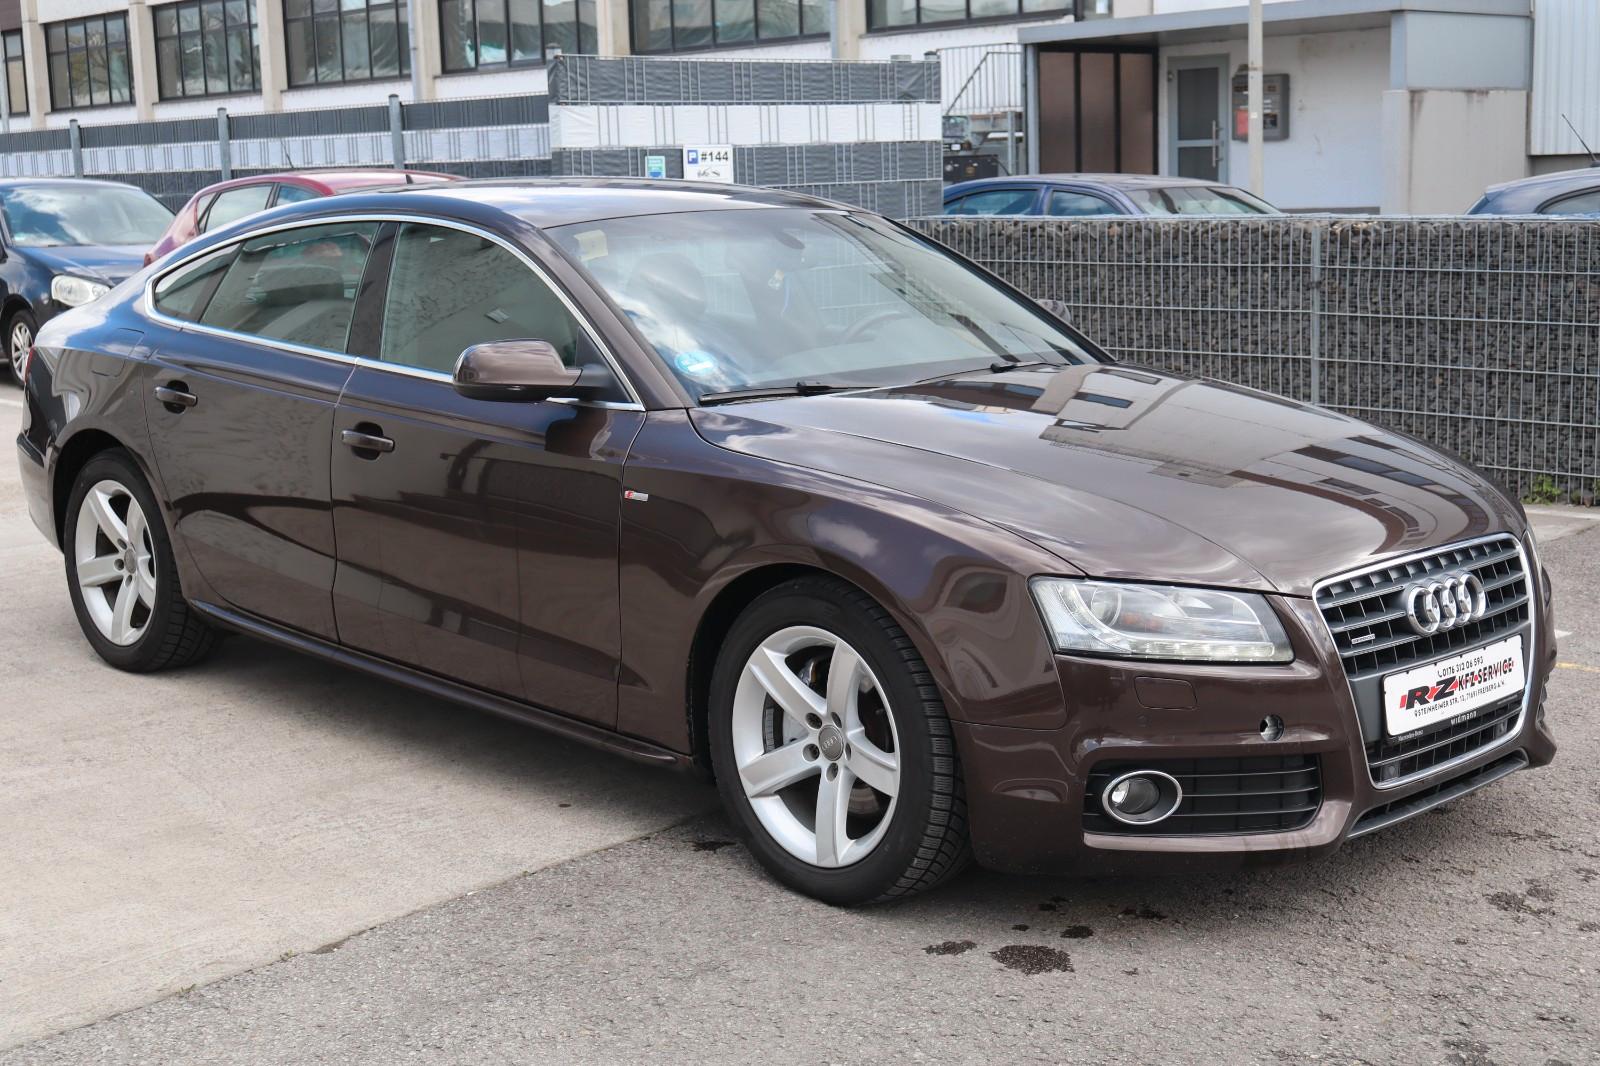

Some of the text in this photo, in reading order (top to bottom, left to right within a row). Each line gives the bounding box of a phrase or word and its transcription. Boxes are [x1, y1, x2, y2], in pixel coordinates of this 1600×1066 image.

[701, 151, 729, 161] #144
[1443, 656, 1484, 677] 0176 312 06 593
[1406, 675, 1457, 710] RZ
